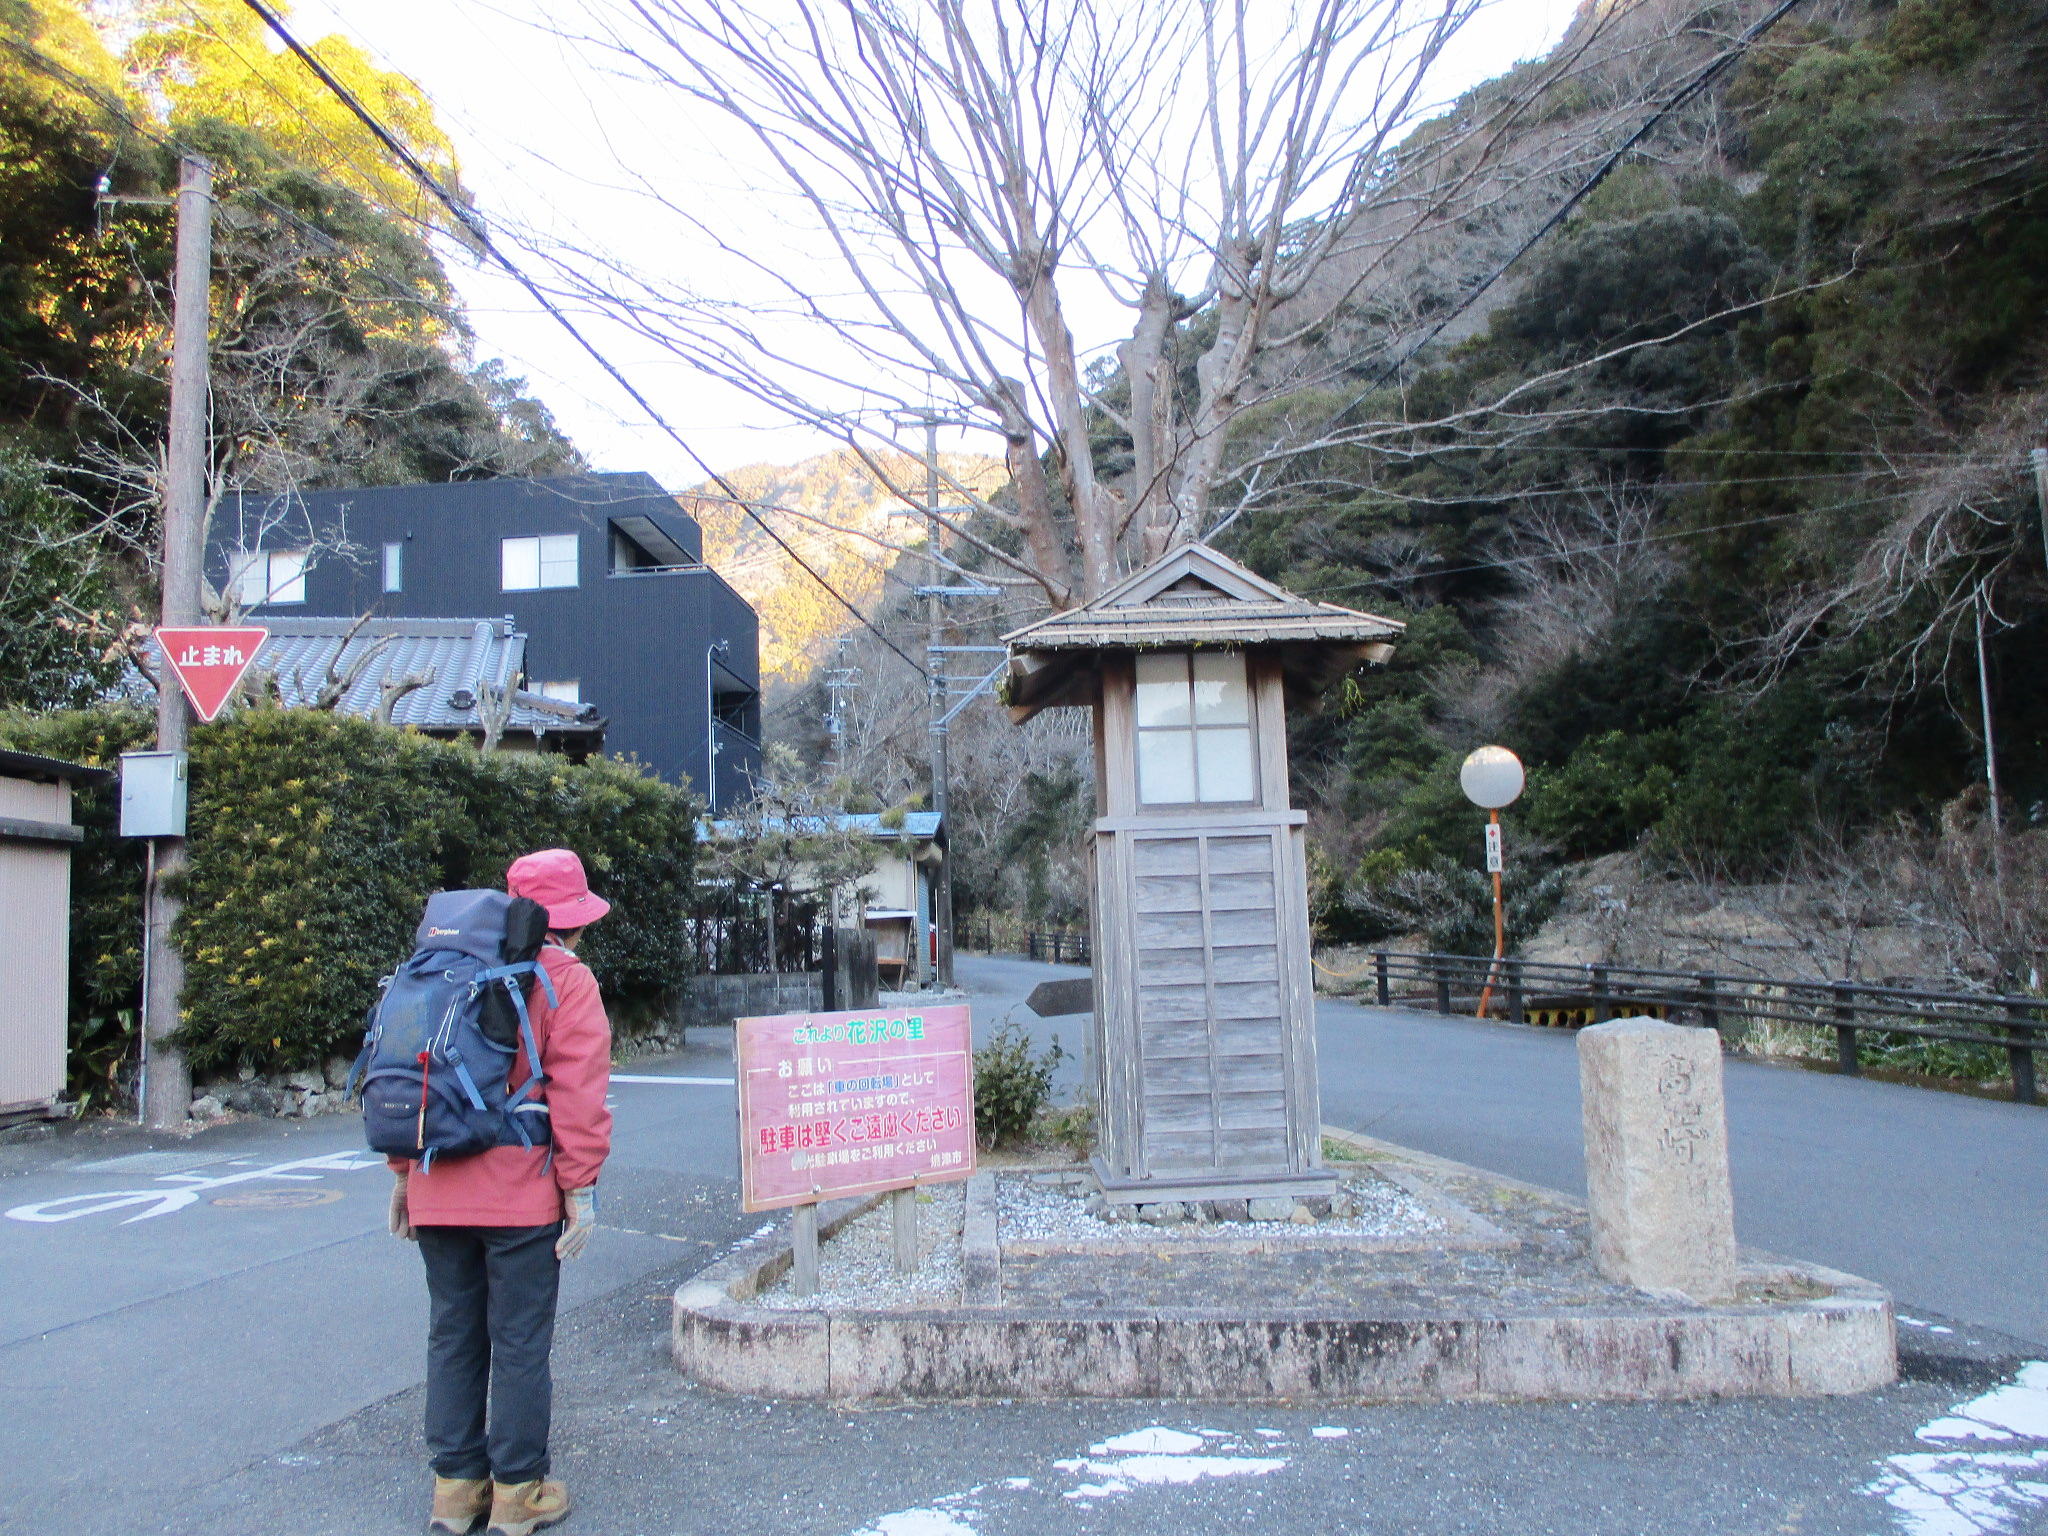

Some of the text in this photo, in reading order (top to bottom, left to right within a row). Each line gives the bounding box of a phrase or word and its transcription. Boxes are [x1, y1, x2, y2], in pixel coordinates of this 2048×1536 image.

[179, 645, 245, 667] 止まれ
[793, 1016, 925, 1045] これより花沢の里
[778, 1057, 832, 1078] お願い
[788, 1091, 916, 1118] 利用されていますので、
[759, 1105, 962, 1156] 駐車は堅くご遠慮ください
